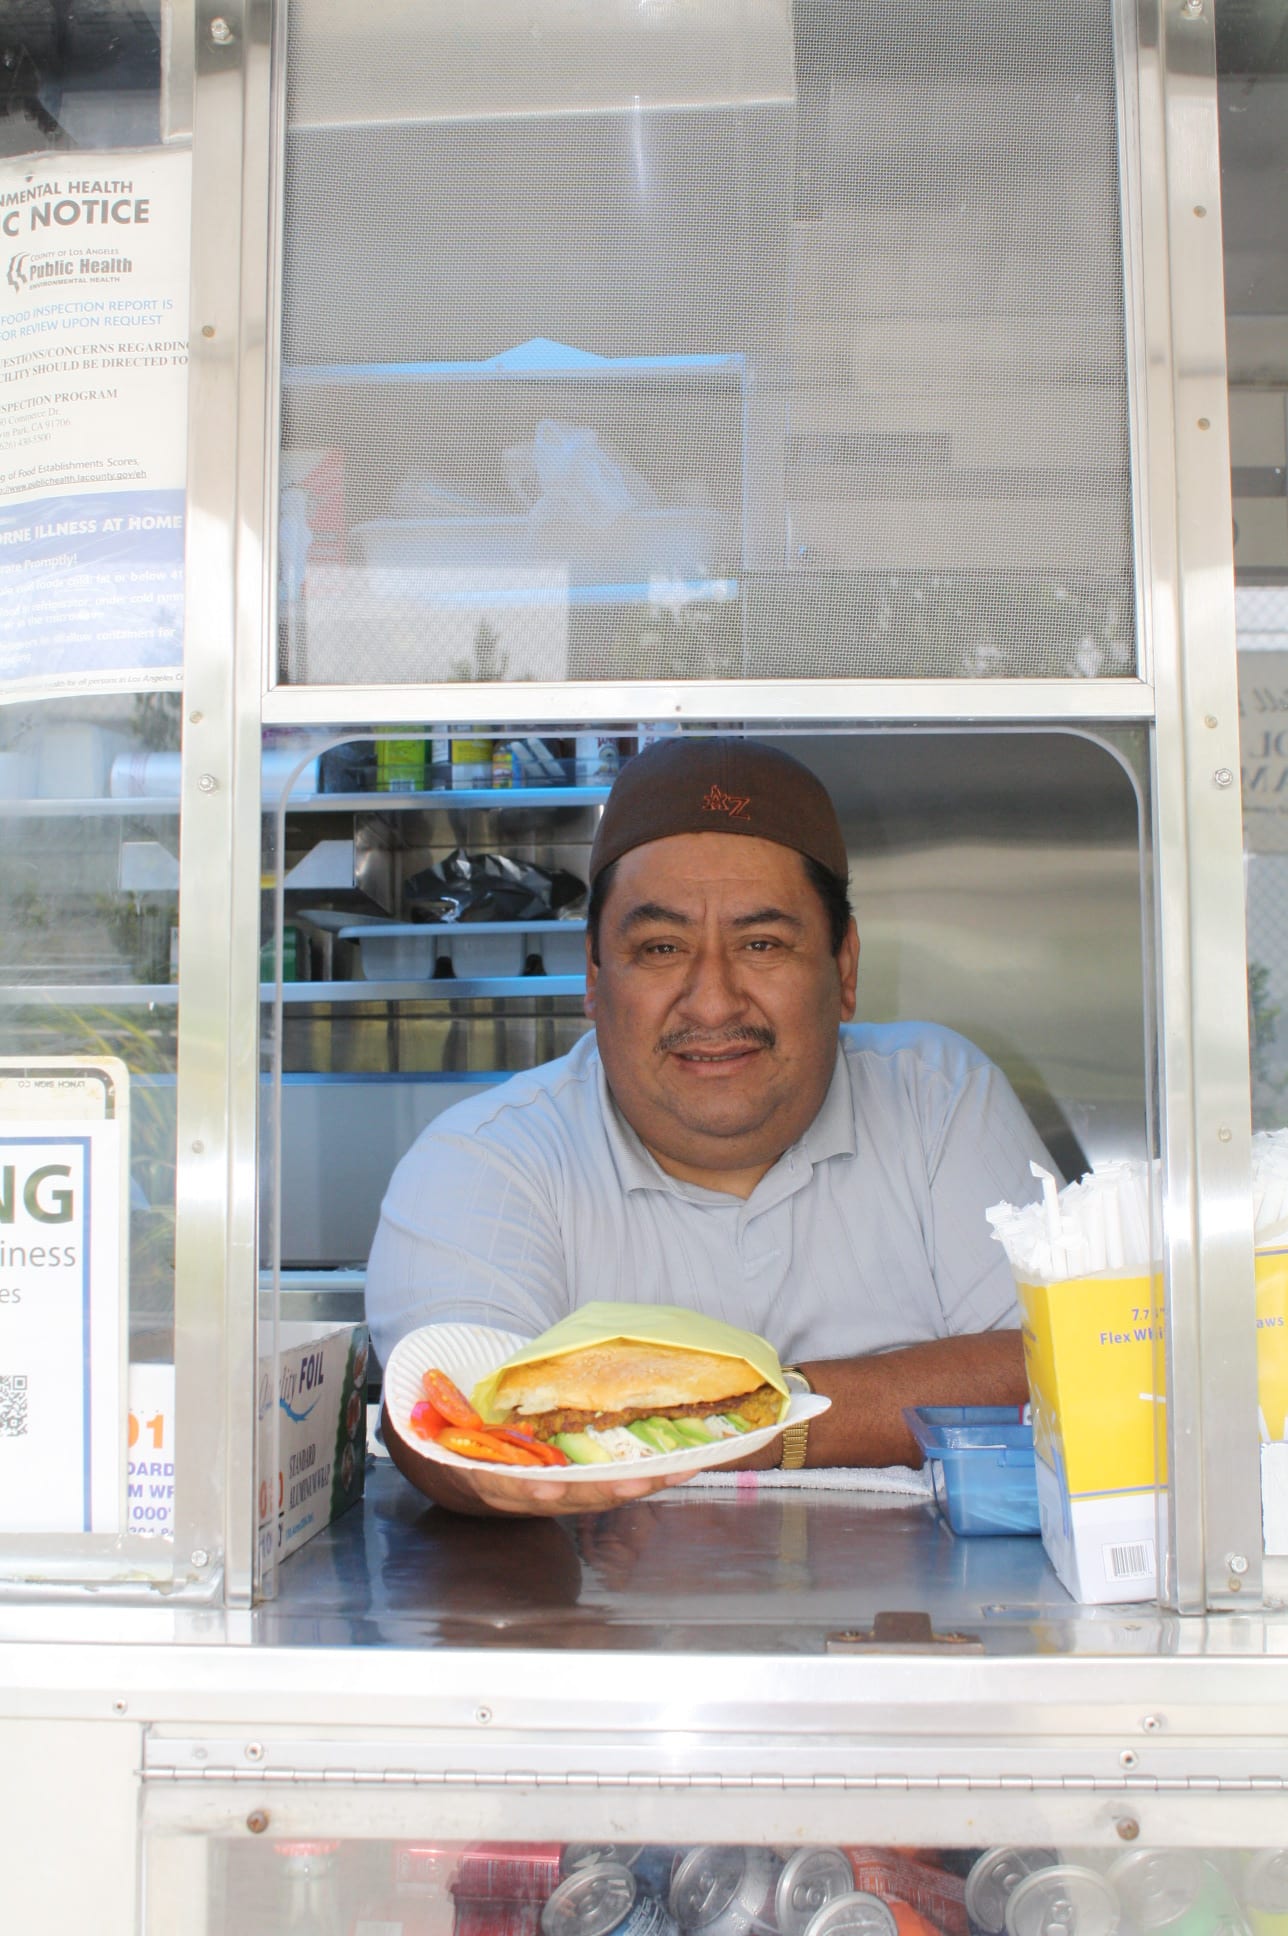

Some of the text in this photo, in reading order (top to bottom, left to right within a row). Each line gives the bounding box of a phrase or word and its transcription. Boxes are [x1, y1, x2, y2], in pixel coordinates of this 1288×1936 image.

[68, 181, 133, 194] HEALTH
[31, 199, 150, 231] NOTICE
[30, 258, 133, 281] Public Health
[29, 276, 120, 291] ENVIRONMENTAL HEALTH
[1, 299, 173, 326] FOOD INSPECTION REPORT IS
[20, 320, 58, 337] REVIEW
[62, 317, 99, 329] UPON
[105, 314, 163, 327] REQUEST
[33, 361, 79, 376] SHOULD
[83, 359, 98, 369] BE
[102, 356, 167, 368] DIRECTED
[171, 355, 188, 366] TO
[54, 388, 118, 402] PROGRAM
[18, 466, 36, 478] Food
[38, 459, 103, 474] Establishments
[35, 519, 96, 539] ILLNESS
[102, 517, 124, 533] AT
[128, 515, 182, 530] HOME
[58, 1080, 85, 1089] LYNCH
[1100, 1331, 1130, 1345] Flex
[298, 1351, 324, 1394] FOIL
[289, 1443, 316, 1480] STANDARD
